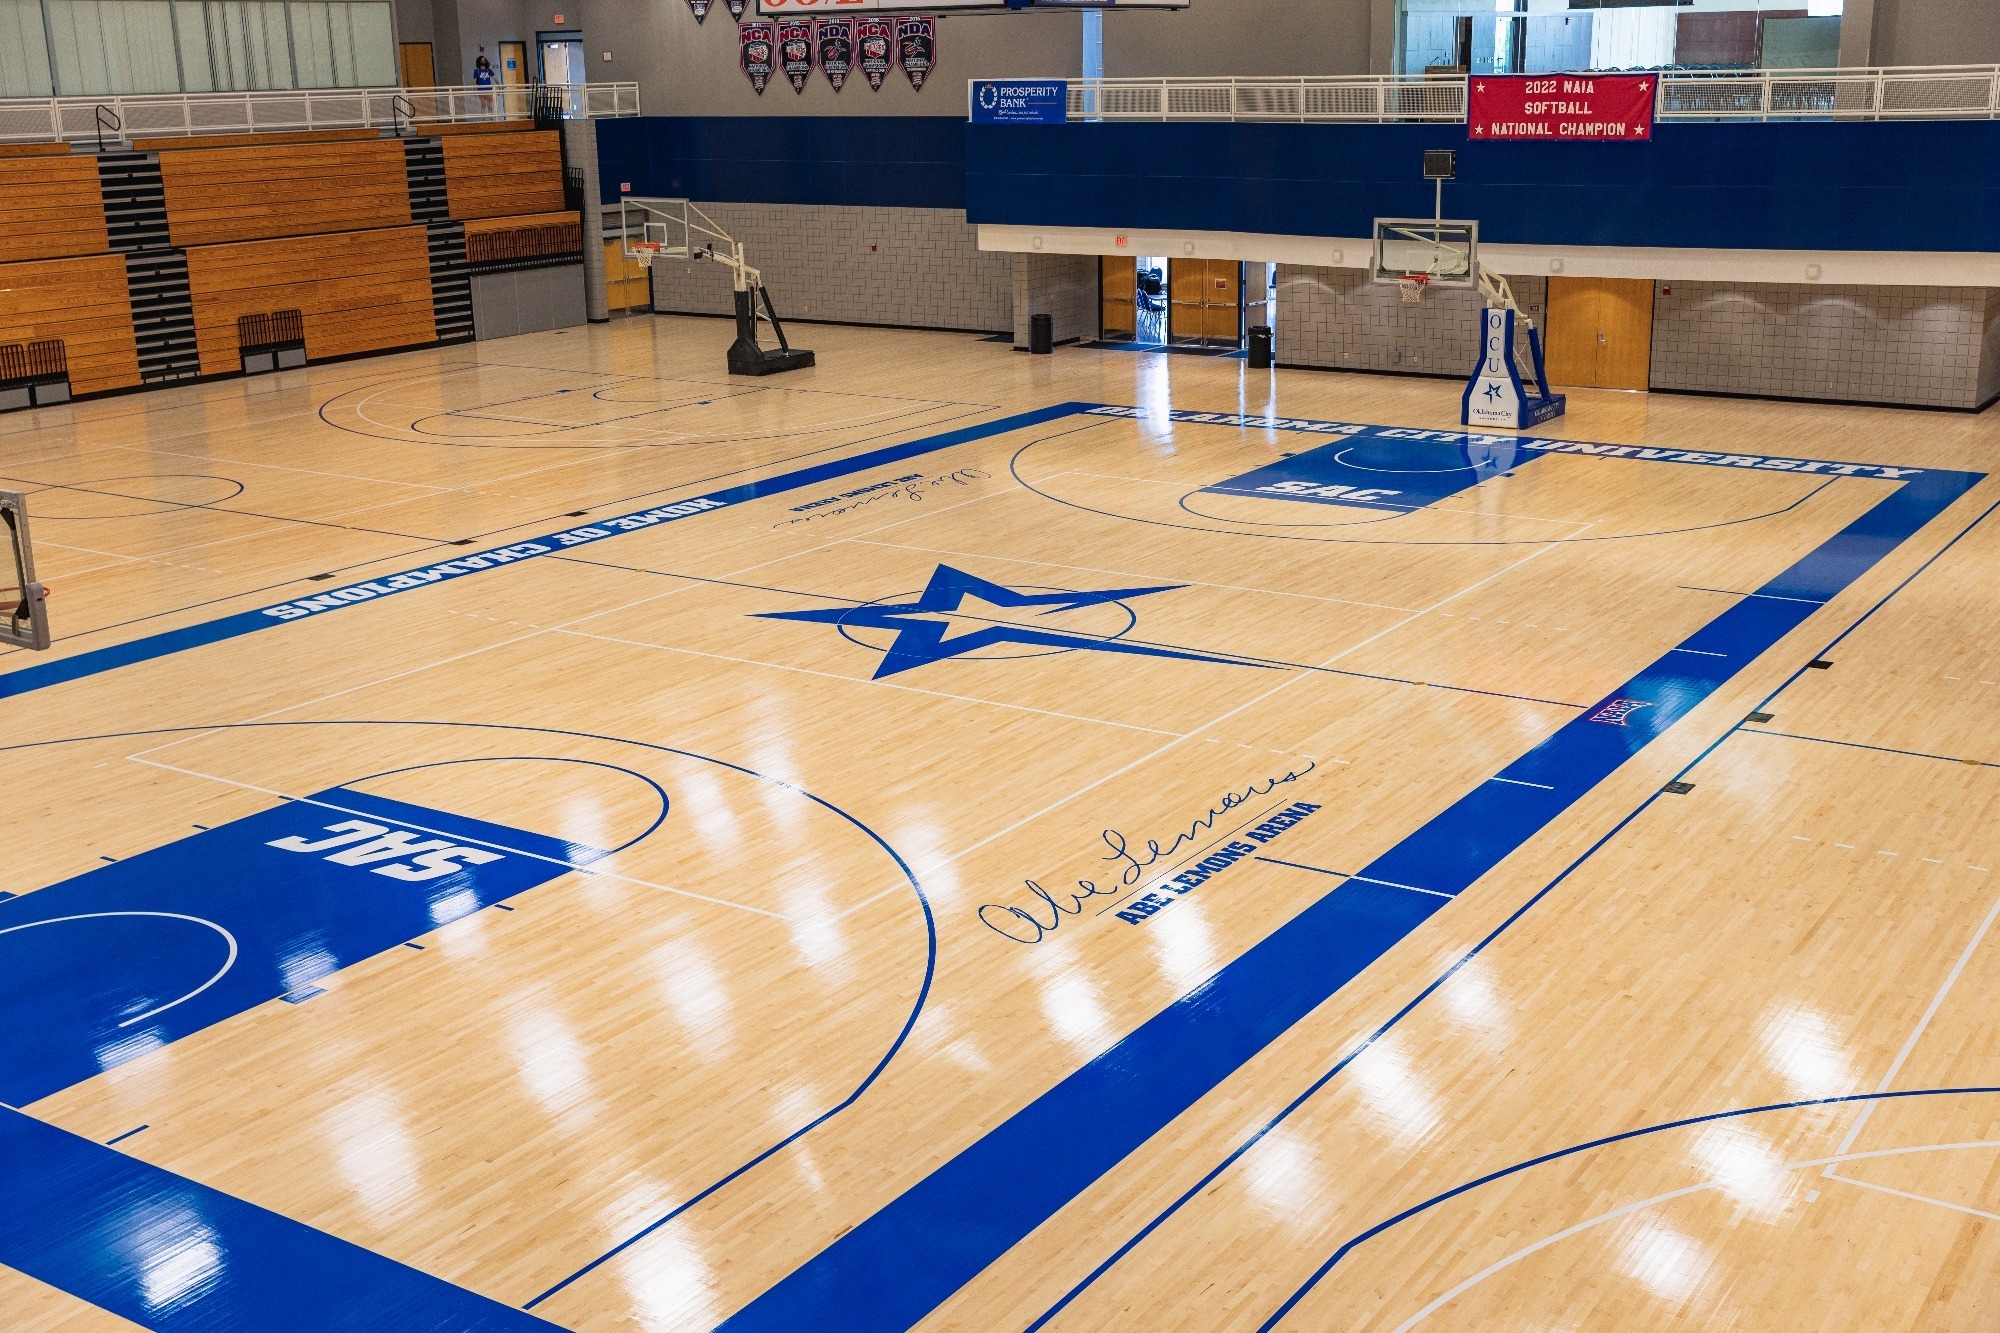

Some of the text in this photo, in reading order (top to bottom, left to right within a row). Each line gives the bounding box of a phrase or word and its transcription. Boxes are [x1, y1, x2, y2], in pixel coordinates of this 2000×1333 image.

[741, 28, 773, 45] NCA
[779, 26, 812, 45] NCA
[818, 25, 852, 43] NDA
[857, 23, 891, 41] NCA
[897, 22, 933, 40] NDA
[1000, 86, 1058, 96] PROSPERITY
[1525, 80, 1594, 94] 2022 NAIA
[1000, 98, 1026, 108] BANK
[1524, 101, 1592, 114] SOFTBALL
[1491, 122, 1625, 136] NATIONAL CHAMPION
[1375, 429, 1518, 445] CITY
[1520, 439, 1925, 479] UNIVERSITY
[1255, 481, 1403, 502] SAC
[262, 498, 728, 620] HOME OF CHAMPIONS
[263, 819, 507, 882] SAC
[1115, 801, 1323, 926] ABE LEMONS ARENA
